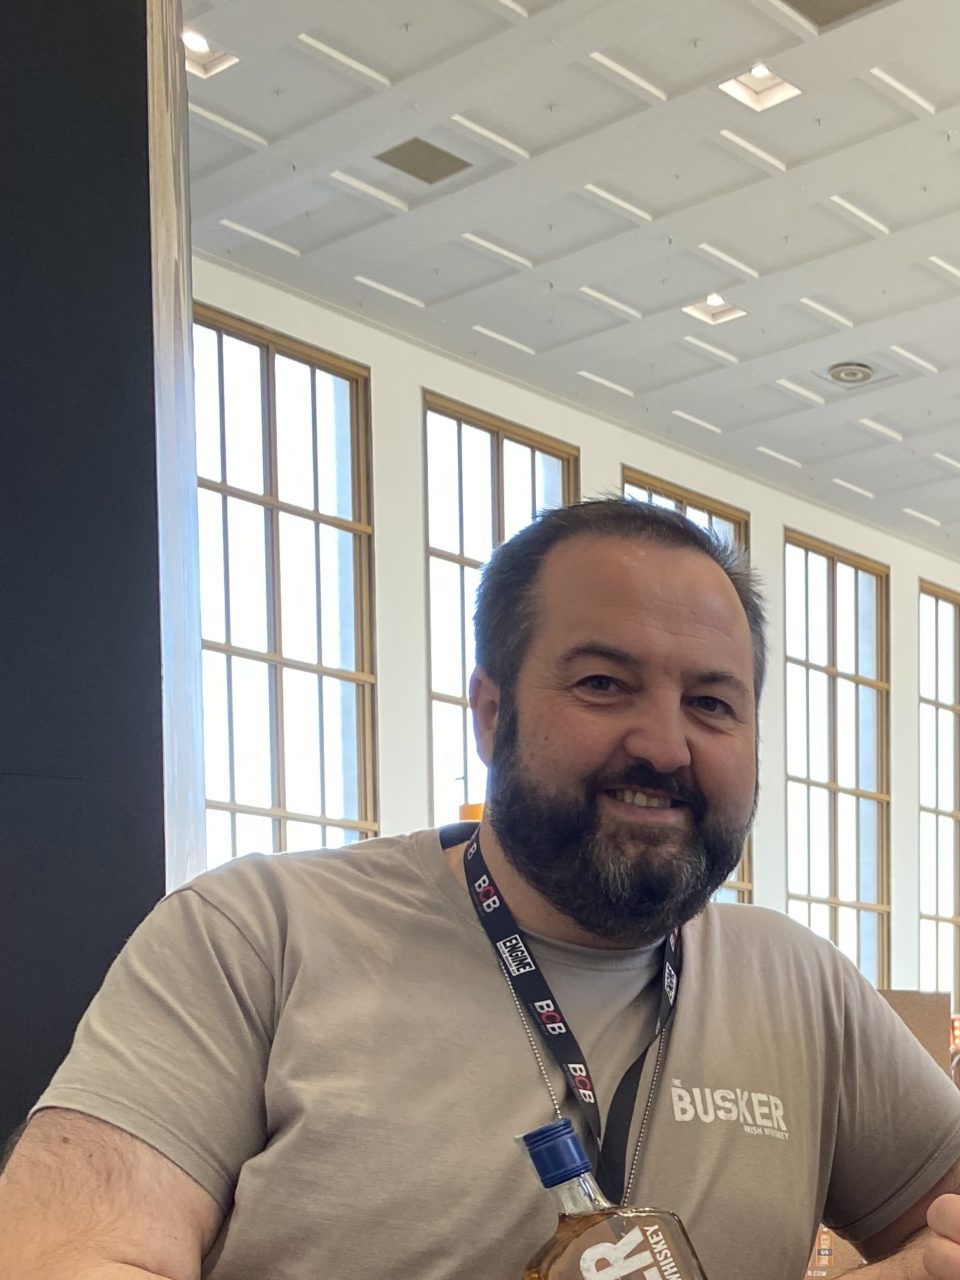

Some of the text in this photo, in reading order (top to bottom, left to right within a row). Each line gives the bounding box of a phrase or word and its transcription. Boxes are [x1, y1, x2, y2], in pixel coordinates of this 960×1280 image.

[474, 874, 501, 913] BCB
[502, 936, 535, 973] ENGINE
[534, 999, 567, 1035] BCB
[567, 1063, 595, 1104] BCB
[671, 1087, 788, 1132] BUSKER
